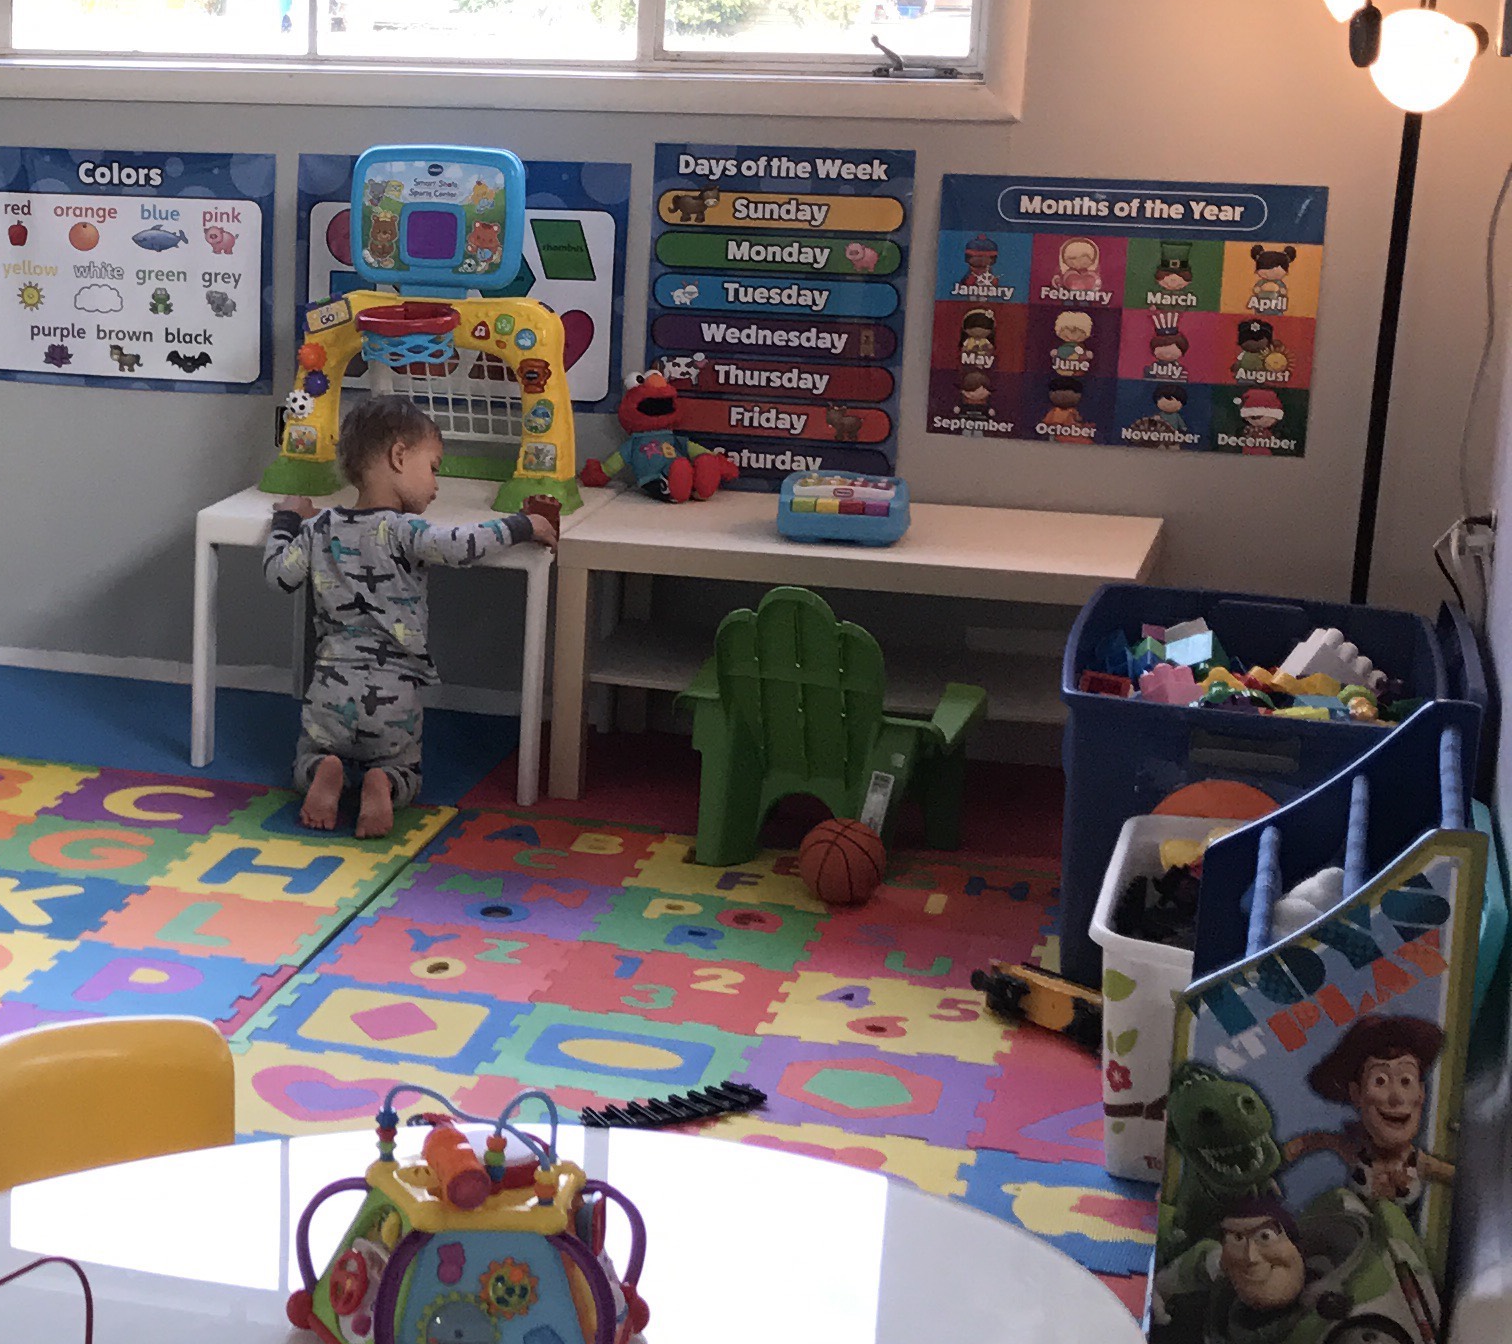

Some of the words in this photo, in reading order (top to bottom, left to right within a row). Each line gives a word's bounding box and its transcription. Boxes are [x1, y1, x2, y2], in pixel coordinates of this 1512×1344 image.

[78, 161, 162, 186] Colors
[678, 154, 737, 179] Days
[740, 156, 768, 177] of
[769, 157, 811, 178] the
[815, 158, 889, 180] Week
[4, 200, 31, 215] red
[53, 206, 118, 222] orange
[141, 204, 180, 221] blue
[202, 207, 242, 225] pink
[733, 198, 830, 226] Sunday
[1020, 195, 1109, 217] Months
[1114, 198, 1142, 218] of
[1145, 200, 1185, 220] the
[1188, 201, 1244, 222] Year
[727, 241, 830, 269] Monday
[2, 260, 58, 278] yellow
[73, 261, 124, 280] white
[136, 267, 187, 285] green
[202, 271, 242, 289] grey
[723, 282, 829, 310] Tuesday
[951, 283, 1014, 300] January
[1040, 287, 1113, 306] February
[1147, 291, 1197, 306] March
[1248, 296, 1287, 312] April
[30, 323, 86, 341] purple
[96, 325, 153, 342] brown
[165, 327, 213, 345] black
[700, 322, 848, 353] Wednesday
[714, 364, 829, 394] Thursday
[961, 352, 995, 369] May
[1052, 356, 1090, 373] June
[1149, 362, 1183, 378] July
[1235, 366, 1291, 384] August
[729, 407, 807, 434] Friday
[934, 417, 1014, 434] September
[1035, 422, 1096, 439] October
[1121, 427, 1200, 444] November
[1217, 434, 1297, 451] December
[103, 785, 214, 821] C
[29, 829, 156, 870] G
[198, 847, 345, 896] H
[155, 901, 230, 947] L
[1185, 872, 1450, 1037] TOYS
[74, 957, 203, 1000] P
[690, 968, 745, 994] 2
[1267, 928, 1448, 1052] PLAY
